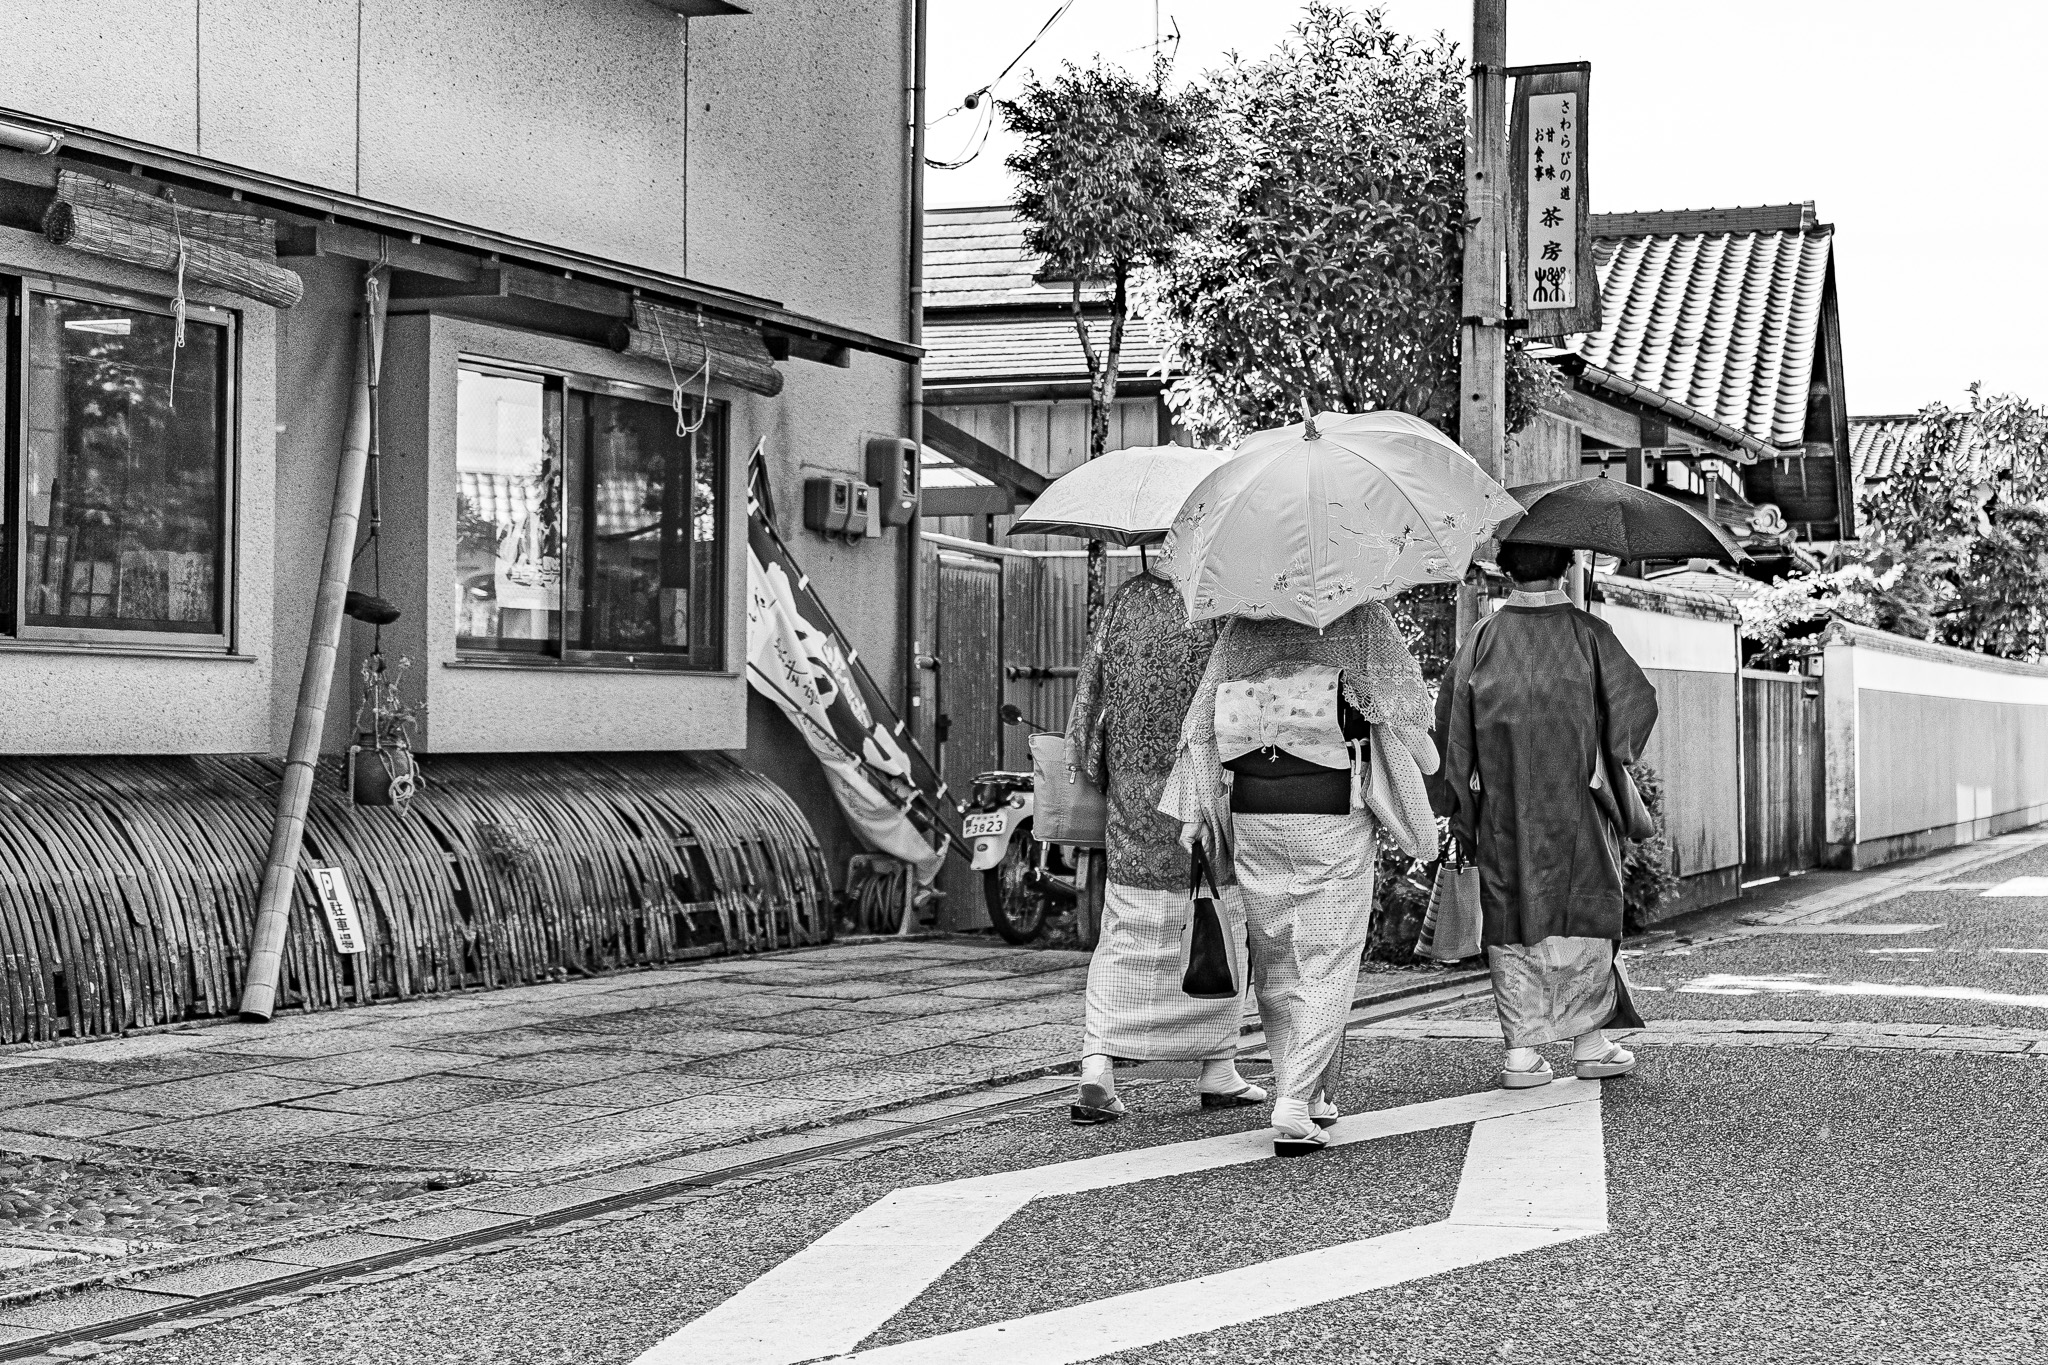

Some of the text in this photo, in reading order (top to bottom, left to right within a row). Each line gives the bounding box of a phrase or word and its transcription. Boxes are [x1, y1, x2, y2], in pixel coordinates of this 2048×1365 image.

[1534, 128, 1545, 182] お食事
[1545, 127, 1556, 181] 甘味
[1560, 100, 1572, 201] さわらびの道
[972, 820, 1004, 834] 3823
[329, 902, 355, 949] 駐車場
